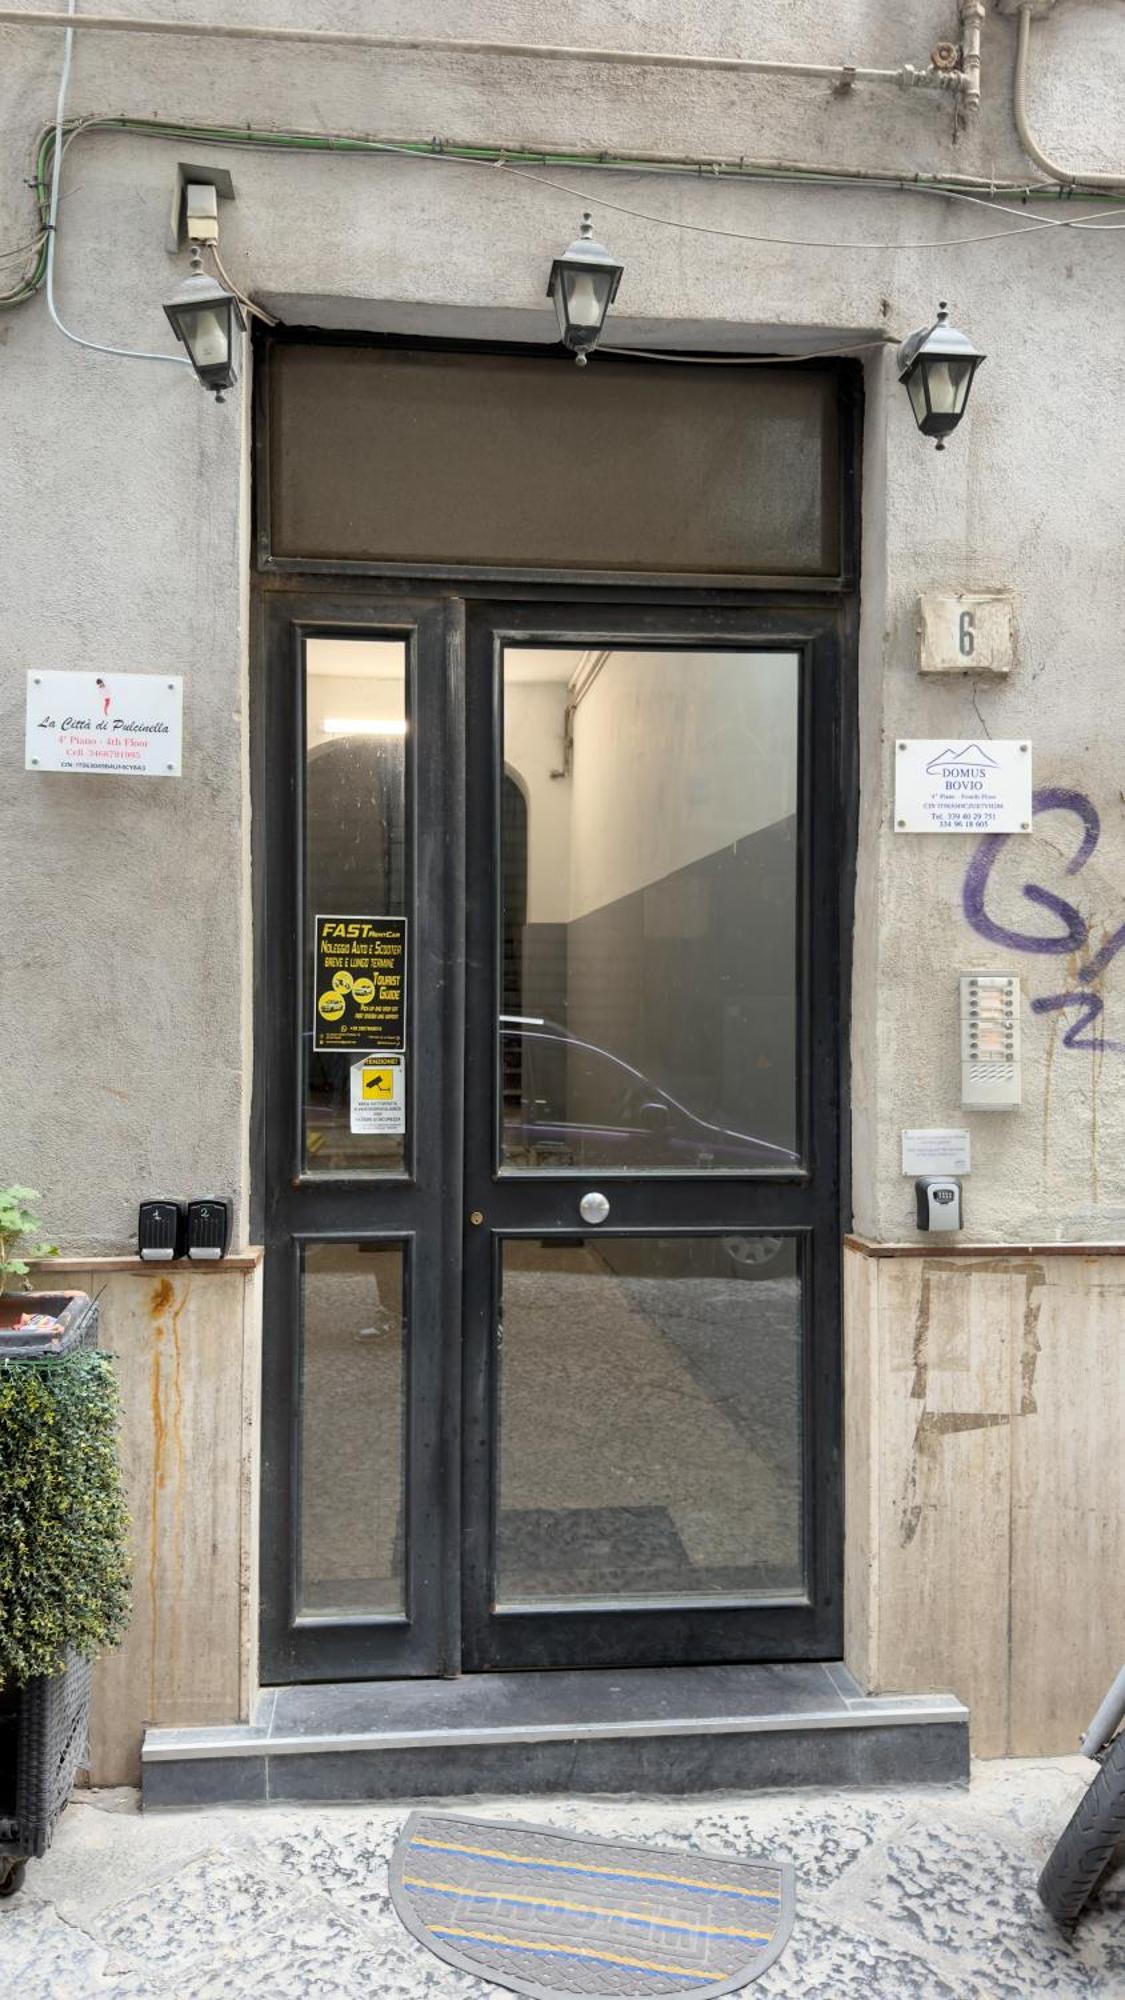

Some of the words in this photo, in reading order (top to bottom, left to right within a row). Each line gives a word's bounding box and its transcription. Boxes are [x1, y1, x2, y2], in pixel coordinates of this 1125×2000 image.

[958, 610, 975, 656] 6
[37, 716, 55, 728] La
[61, 717, 91, 731] Città
[96, 720, 108, 731] di
[112, 719, 169, 733] Pulcinella
[70, 735, 97, 745] Piano
[124, 738, 148, 748] Floor
[942, 768, 986, 778] DOMUS
[945, 780, 984, 790] BOVIO
[322, 923, 373, 938] FAST
[324, 957, 343, 968] BREVE
[344, 957, 349, 968] E
[350, 957, 369, 968] LUNGO
[370, 957, 395, 969] TERMINE
[200, 1207, 210, 1218] 2
